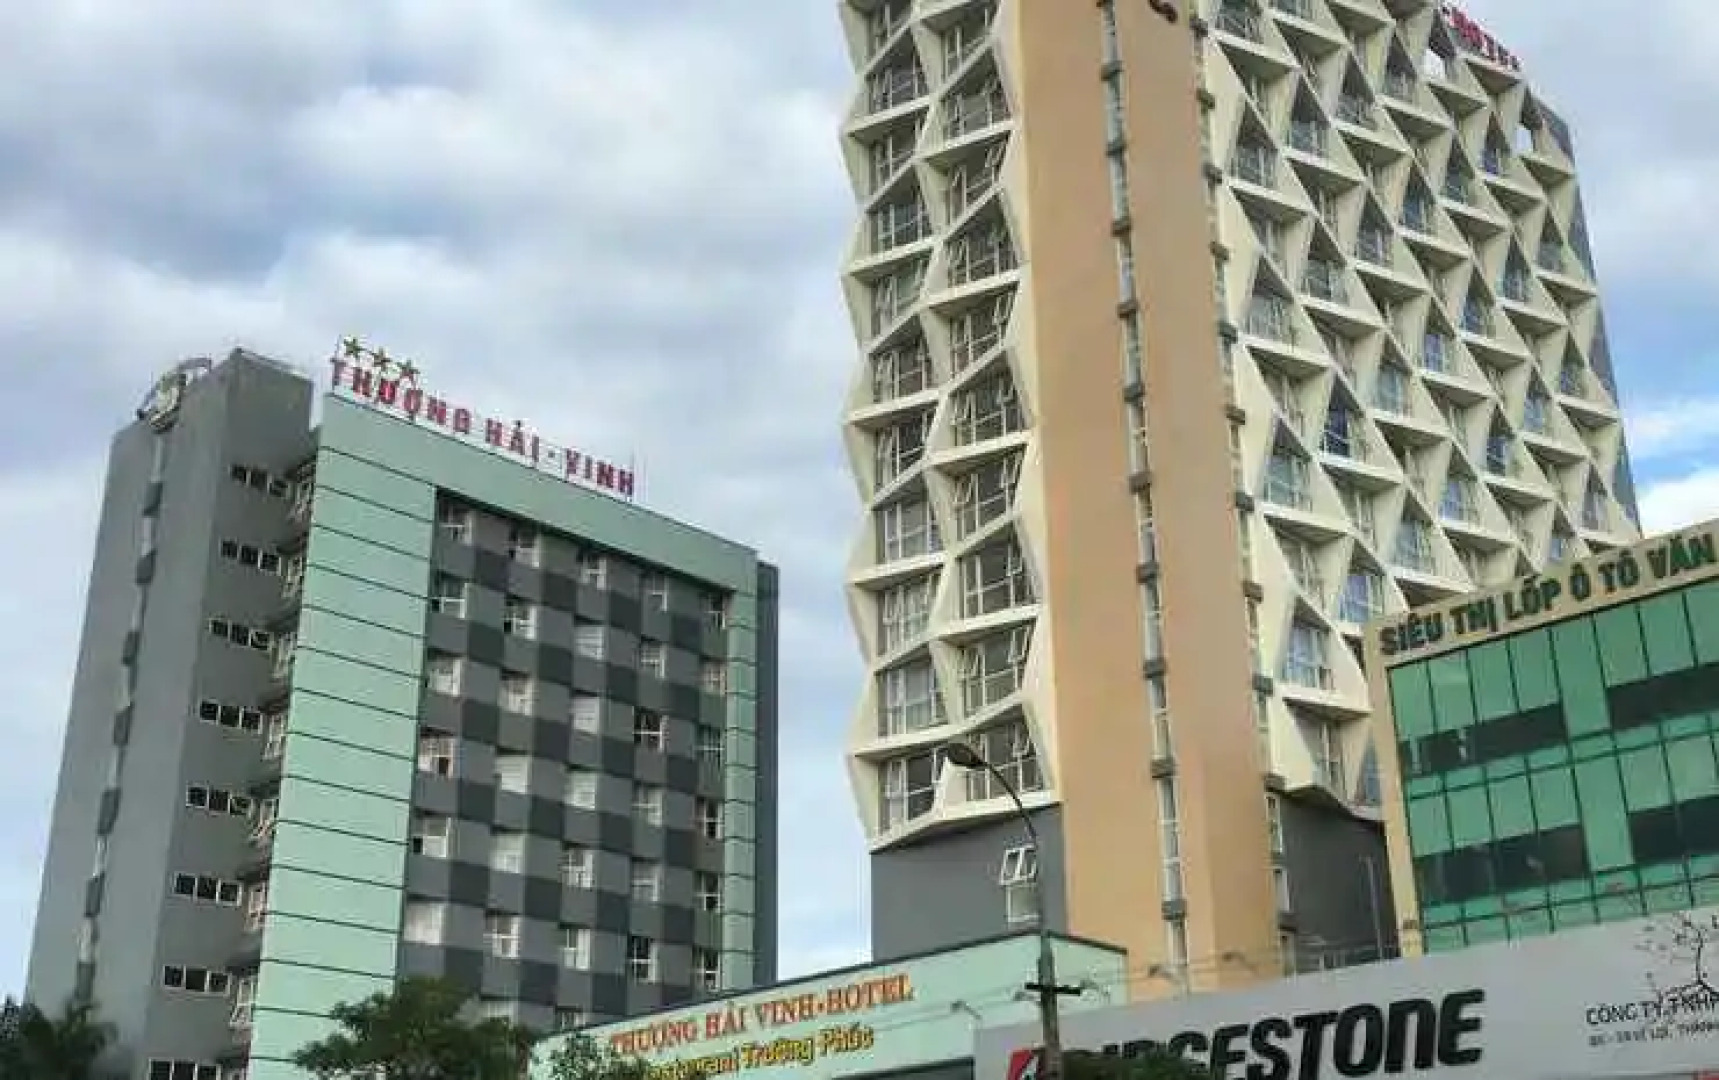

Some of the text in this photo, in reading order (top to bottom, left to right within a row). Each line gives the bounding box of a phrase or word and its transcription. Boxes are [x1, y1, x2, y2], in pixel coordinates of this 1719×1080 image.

[1380, 611, 1444, 656] SIÊU
[1570, 562, 1592, 602] Ô
[1598, 549, 1640, 595] TÔ
